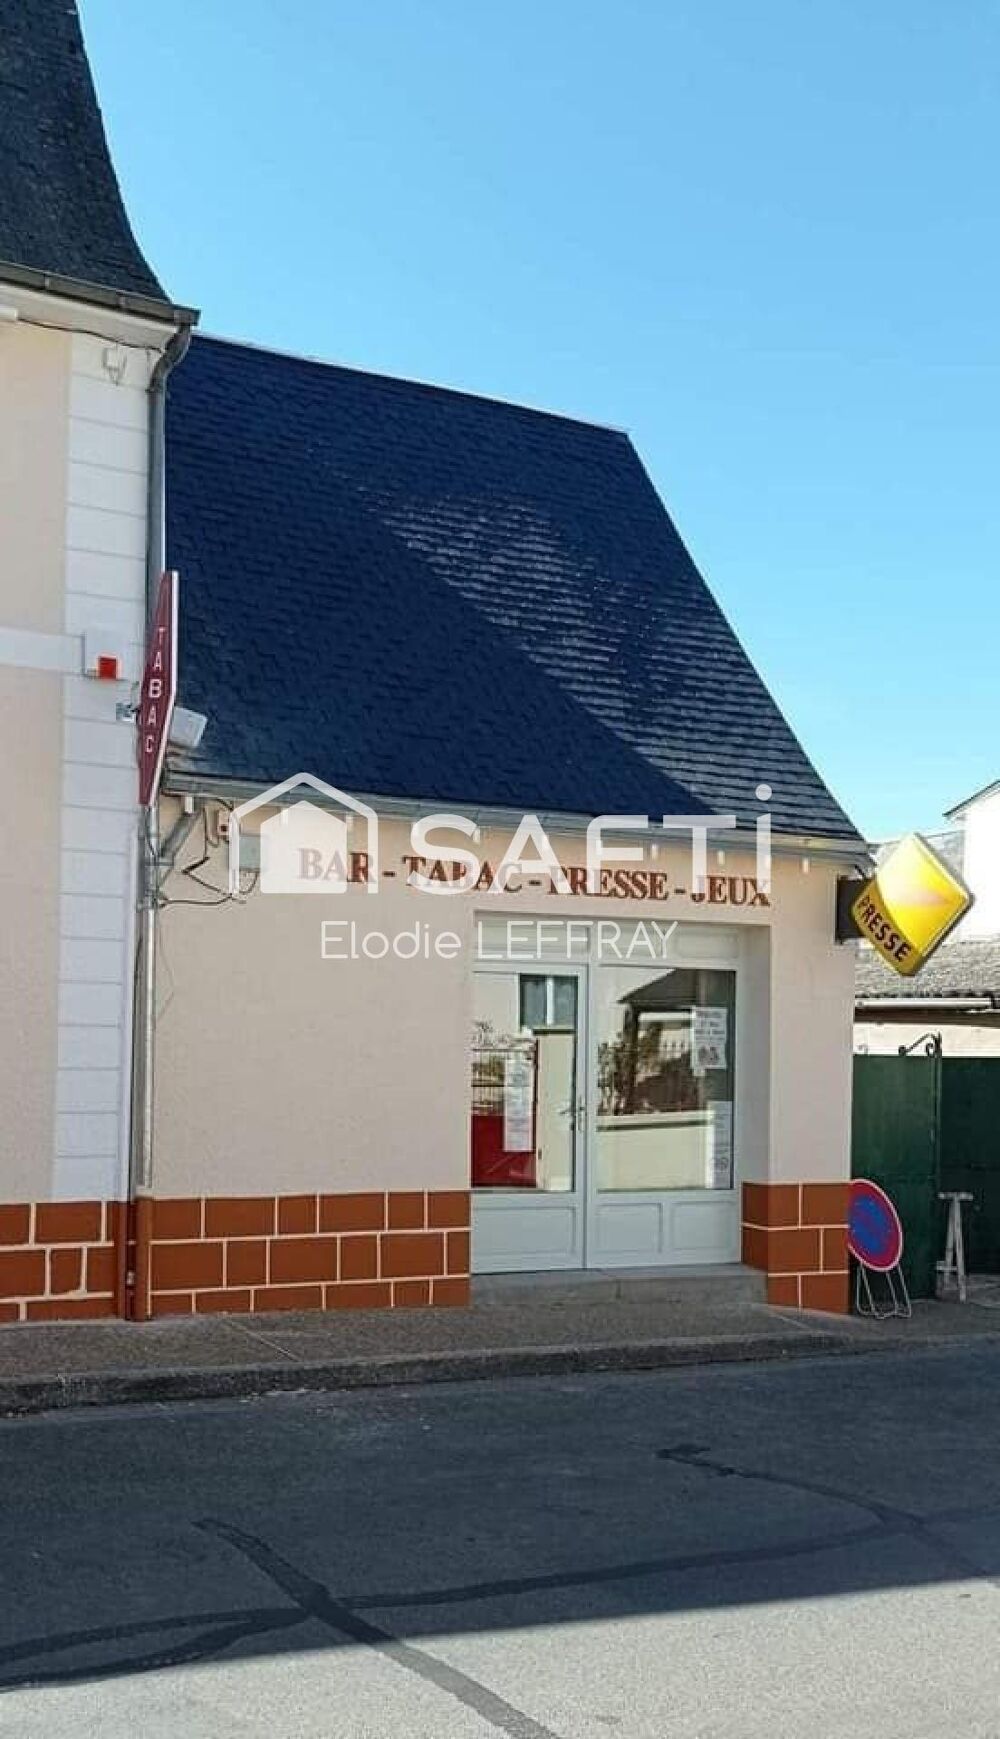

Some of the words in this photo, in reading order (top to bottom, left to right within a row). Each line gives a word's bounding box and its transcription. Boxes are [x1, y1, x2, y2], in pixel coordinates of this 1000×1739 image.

[145, 626, 167, 753] TABAC
[298, 847, 377, 884] BAR
[857, 894, 913, 962] PRESSE
